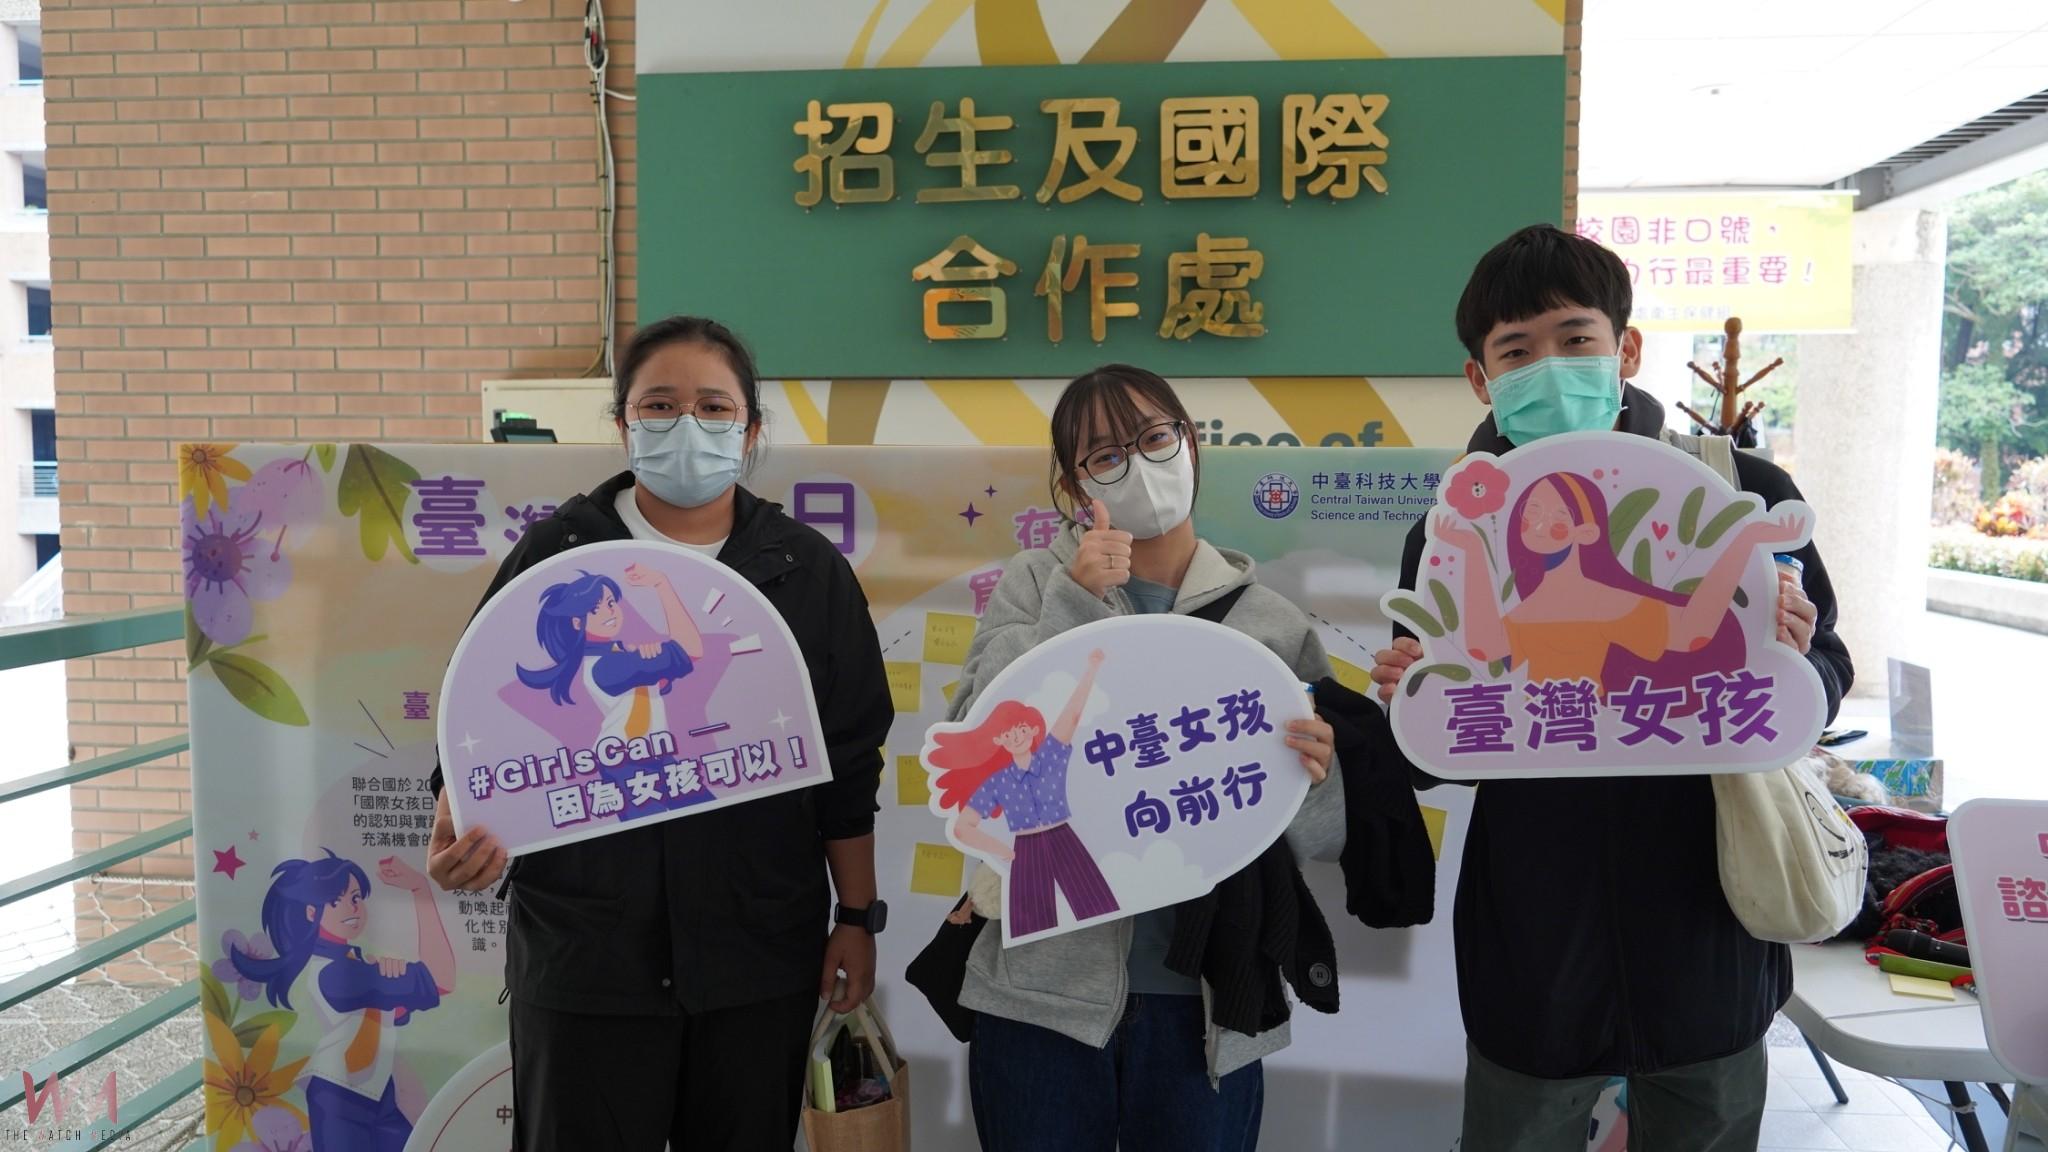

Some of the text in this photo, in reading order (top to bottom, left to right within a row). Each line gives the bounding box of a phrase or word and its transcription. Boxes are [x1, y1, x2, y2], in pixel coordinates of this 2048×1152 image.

[794, 94, 1390, 206] 招生及國際
[912, 232, 1265, 342] 合作處
[410, 475, 557, 557] 臺
[1311, 472, 1441, 491] 中臺科技大學
[1311, 494, 1351, 505] Central
[1355, 494, 1394, 505] Taiwan
[1311, 510, 1355, 521] Science
[1358, 510, 1379, 521] and
[402, 690, 431, 720] 臺
[1084, 688, 1274, 777] 中臺女孩
[1444, 671, 1778, 755] 臺灣女孩
[352, 777, 412, 792] 聯合國於
[469, 728, 678, 801] #GirlsCan
[547, 736, 808, 829] 因為女孩可以！
[1125, 762, 1267, 838] 向前行
[458, 900, 511, 916] 動喚起
[496, 1104, 513, 1126] 中
